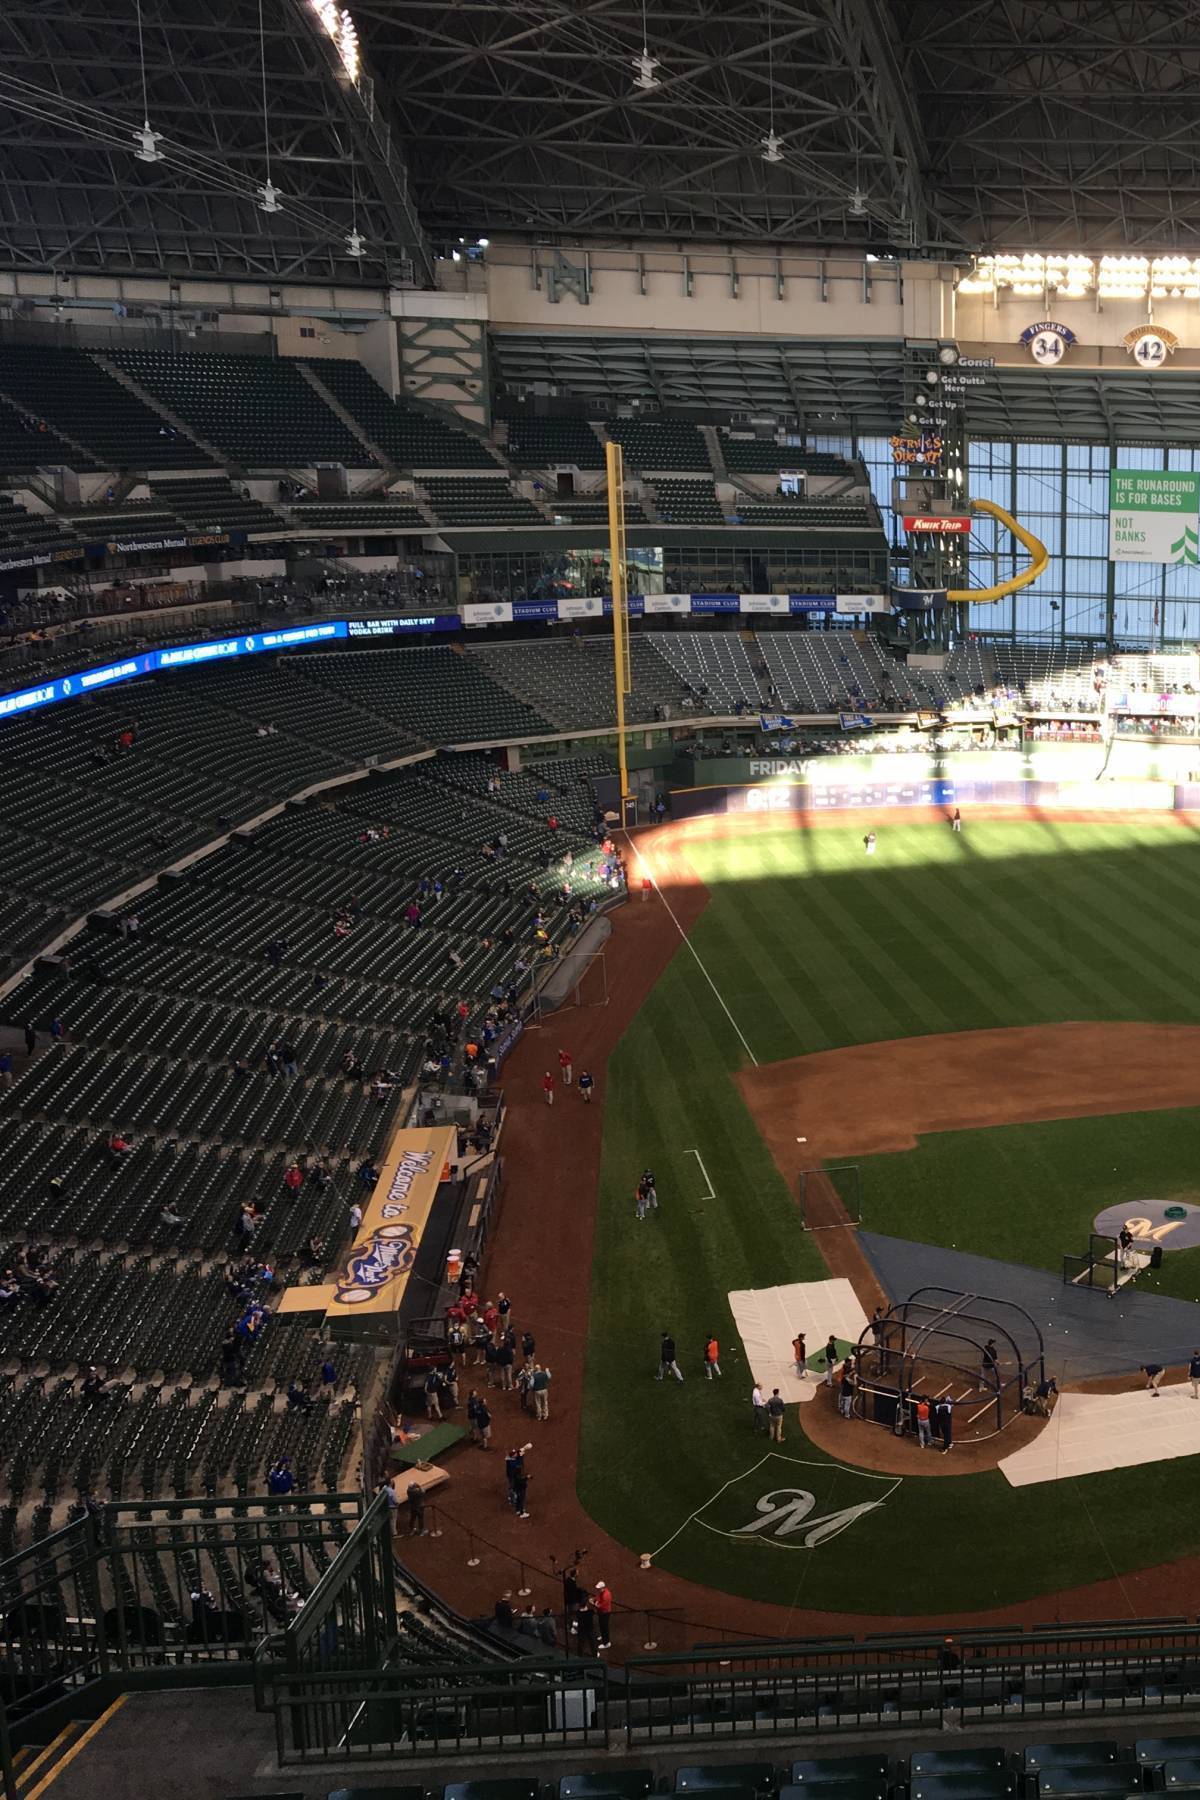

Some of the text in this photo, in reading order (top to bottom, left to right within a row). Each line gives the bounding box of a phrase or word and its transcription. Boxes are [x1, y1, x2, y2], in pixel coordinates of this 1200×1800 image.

[1029, 324, 1067, 337] FINGERS
[1035, 338, 1060, 358] 34
[1137, 341, 1163, 361] 42
[958, 357, 995, 368] Gone!
[941, 376, 985, 385] Get Outta
[936, 418, 947, 426] Up
[1116, 479, 1195, 493] THE RUNAROUND
[1116, 492, 1182, 506] IS FOR BASES
[1115, 517, 1133, 529] NOT
[1115, 531, 1146, 542] BANKS
[117, 541, 162, 553] Northwestern
[164, 538, 186, 548] Mutual
[0, 558, 33, 571] orthwestern
[367, 620, 380, 628] BAR
[380, 619, 398, 627] WITH
[400, 618, 418, 626] DAILY
[349, 628, 371, 636] VODKA
[381, 1151, 435, 1219] Welcome to
